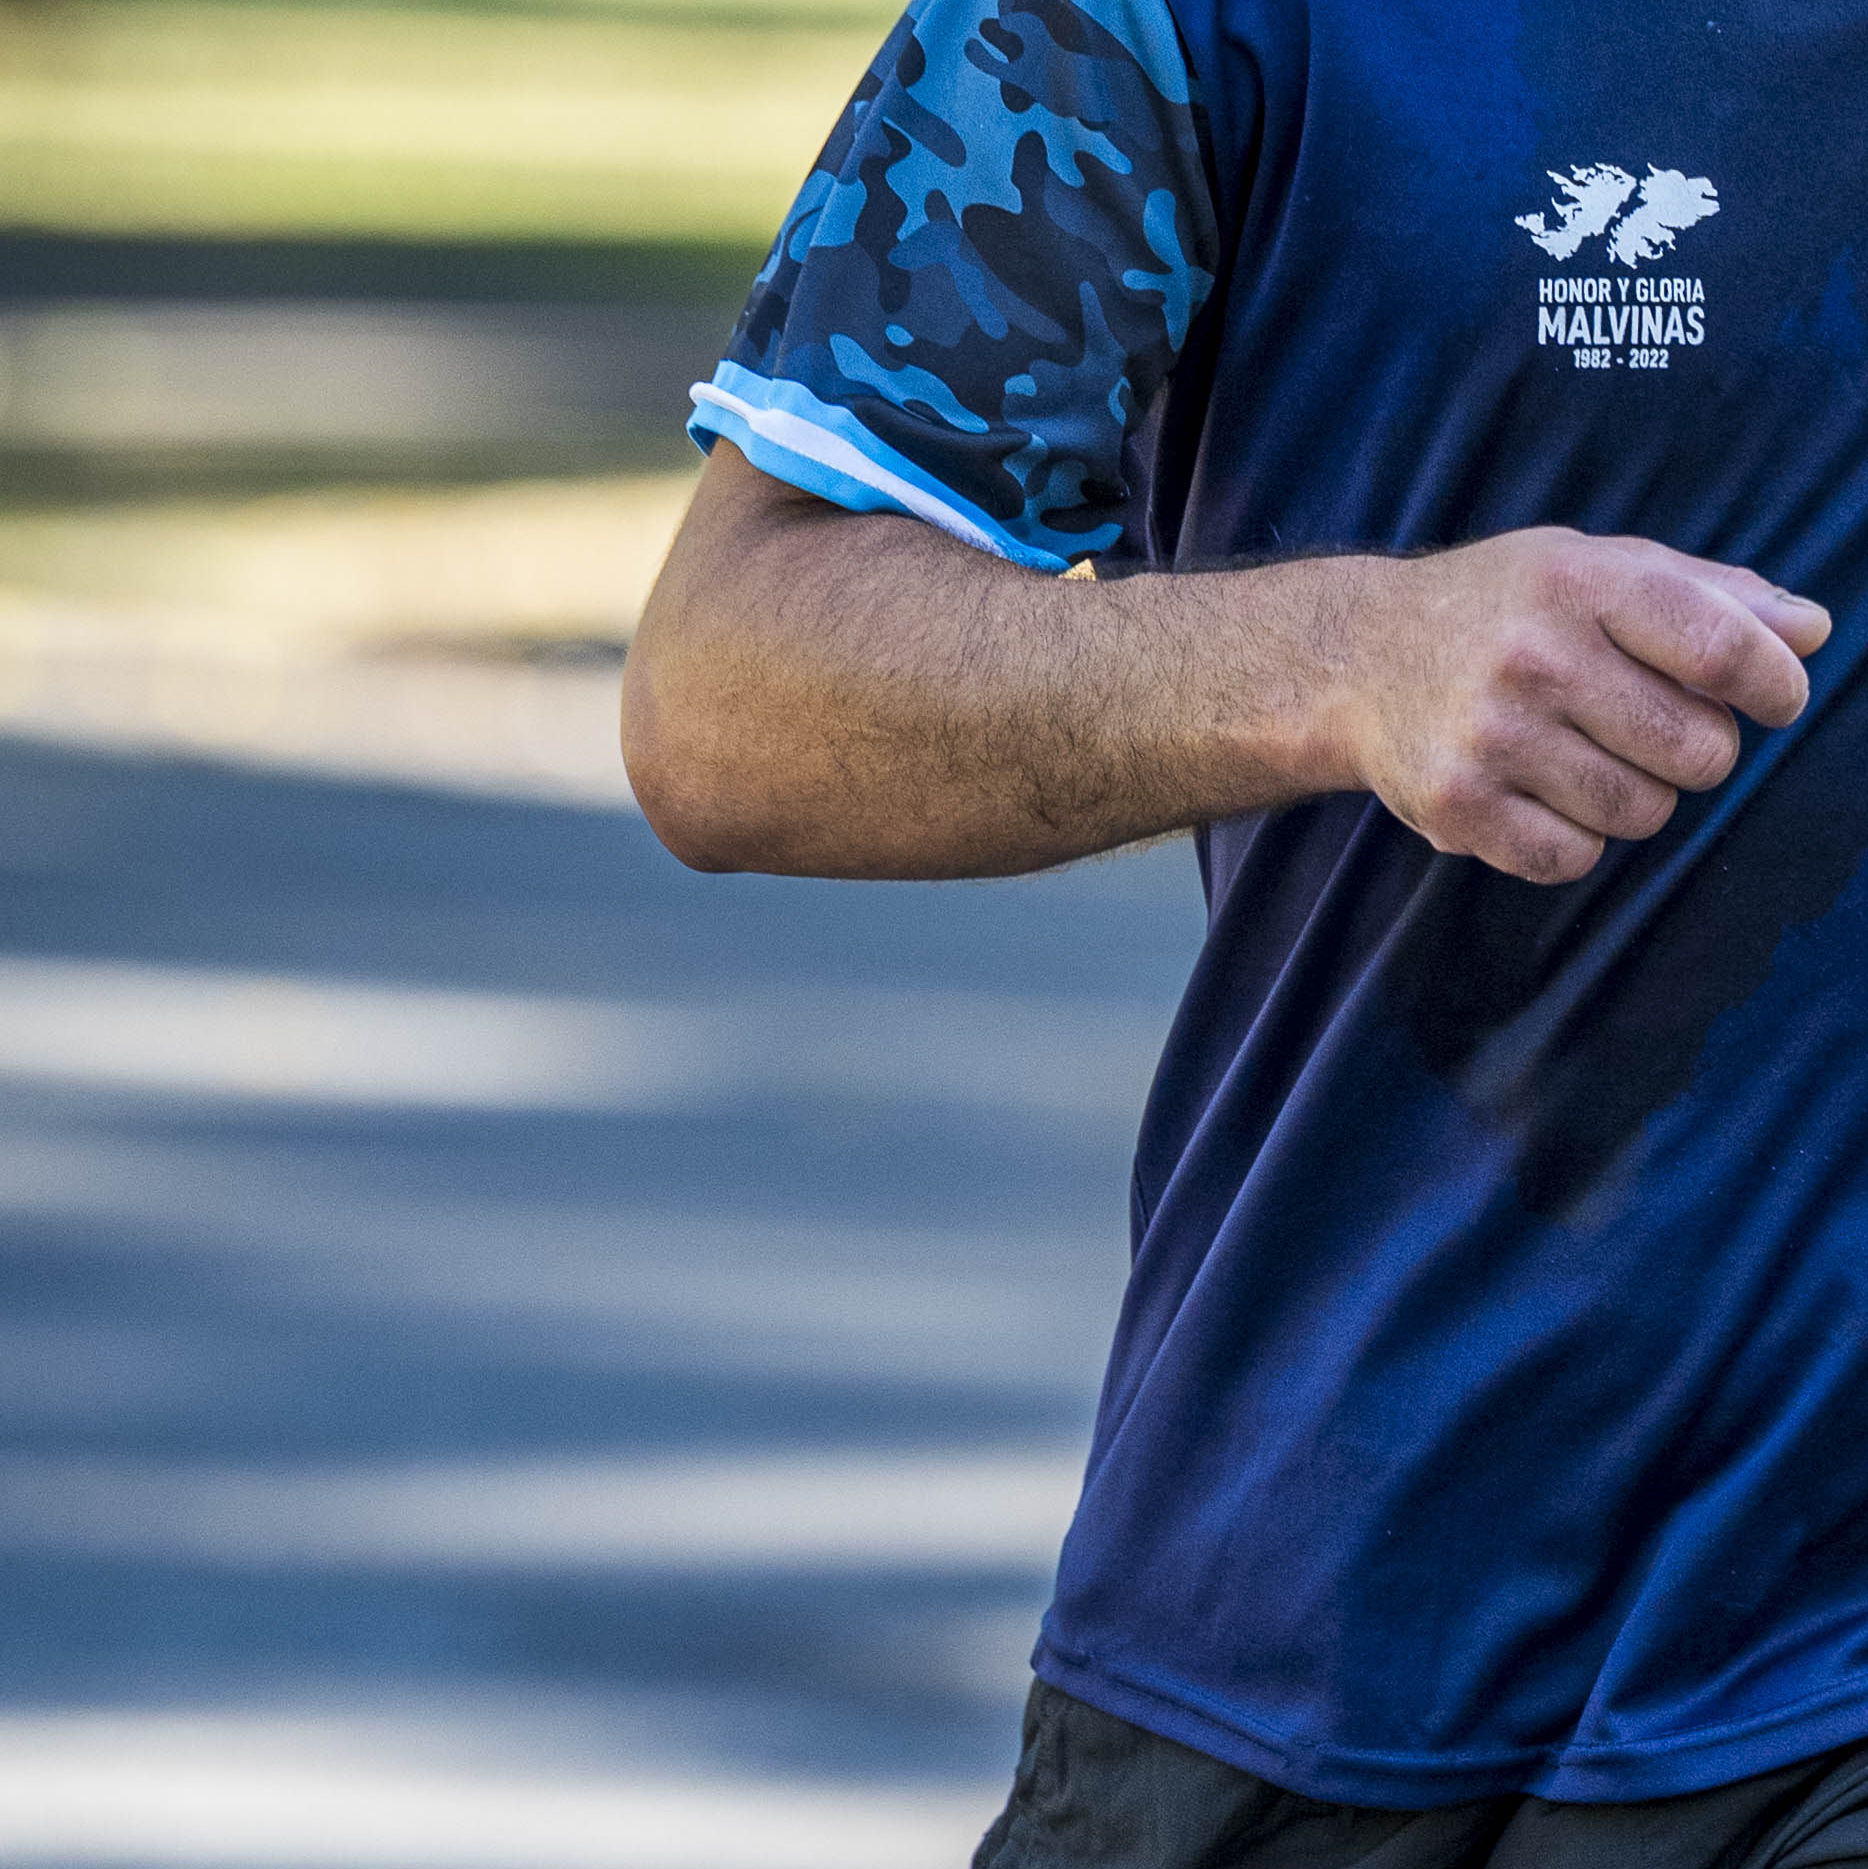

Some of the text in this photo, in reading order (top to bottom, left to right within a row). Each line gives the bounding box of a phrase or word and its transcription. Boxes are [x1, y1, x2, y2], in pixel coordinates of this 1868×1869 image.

[1538, 277, 1705, 303] HONOR Y GLORIA
[1538, 306, 1705, 345] MALVINAS
[1573, 347, 1611, 369] 1982
[1629, 347, 1669, 369] 2022
